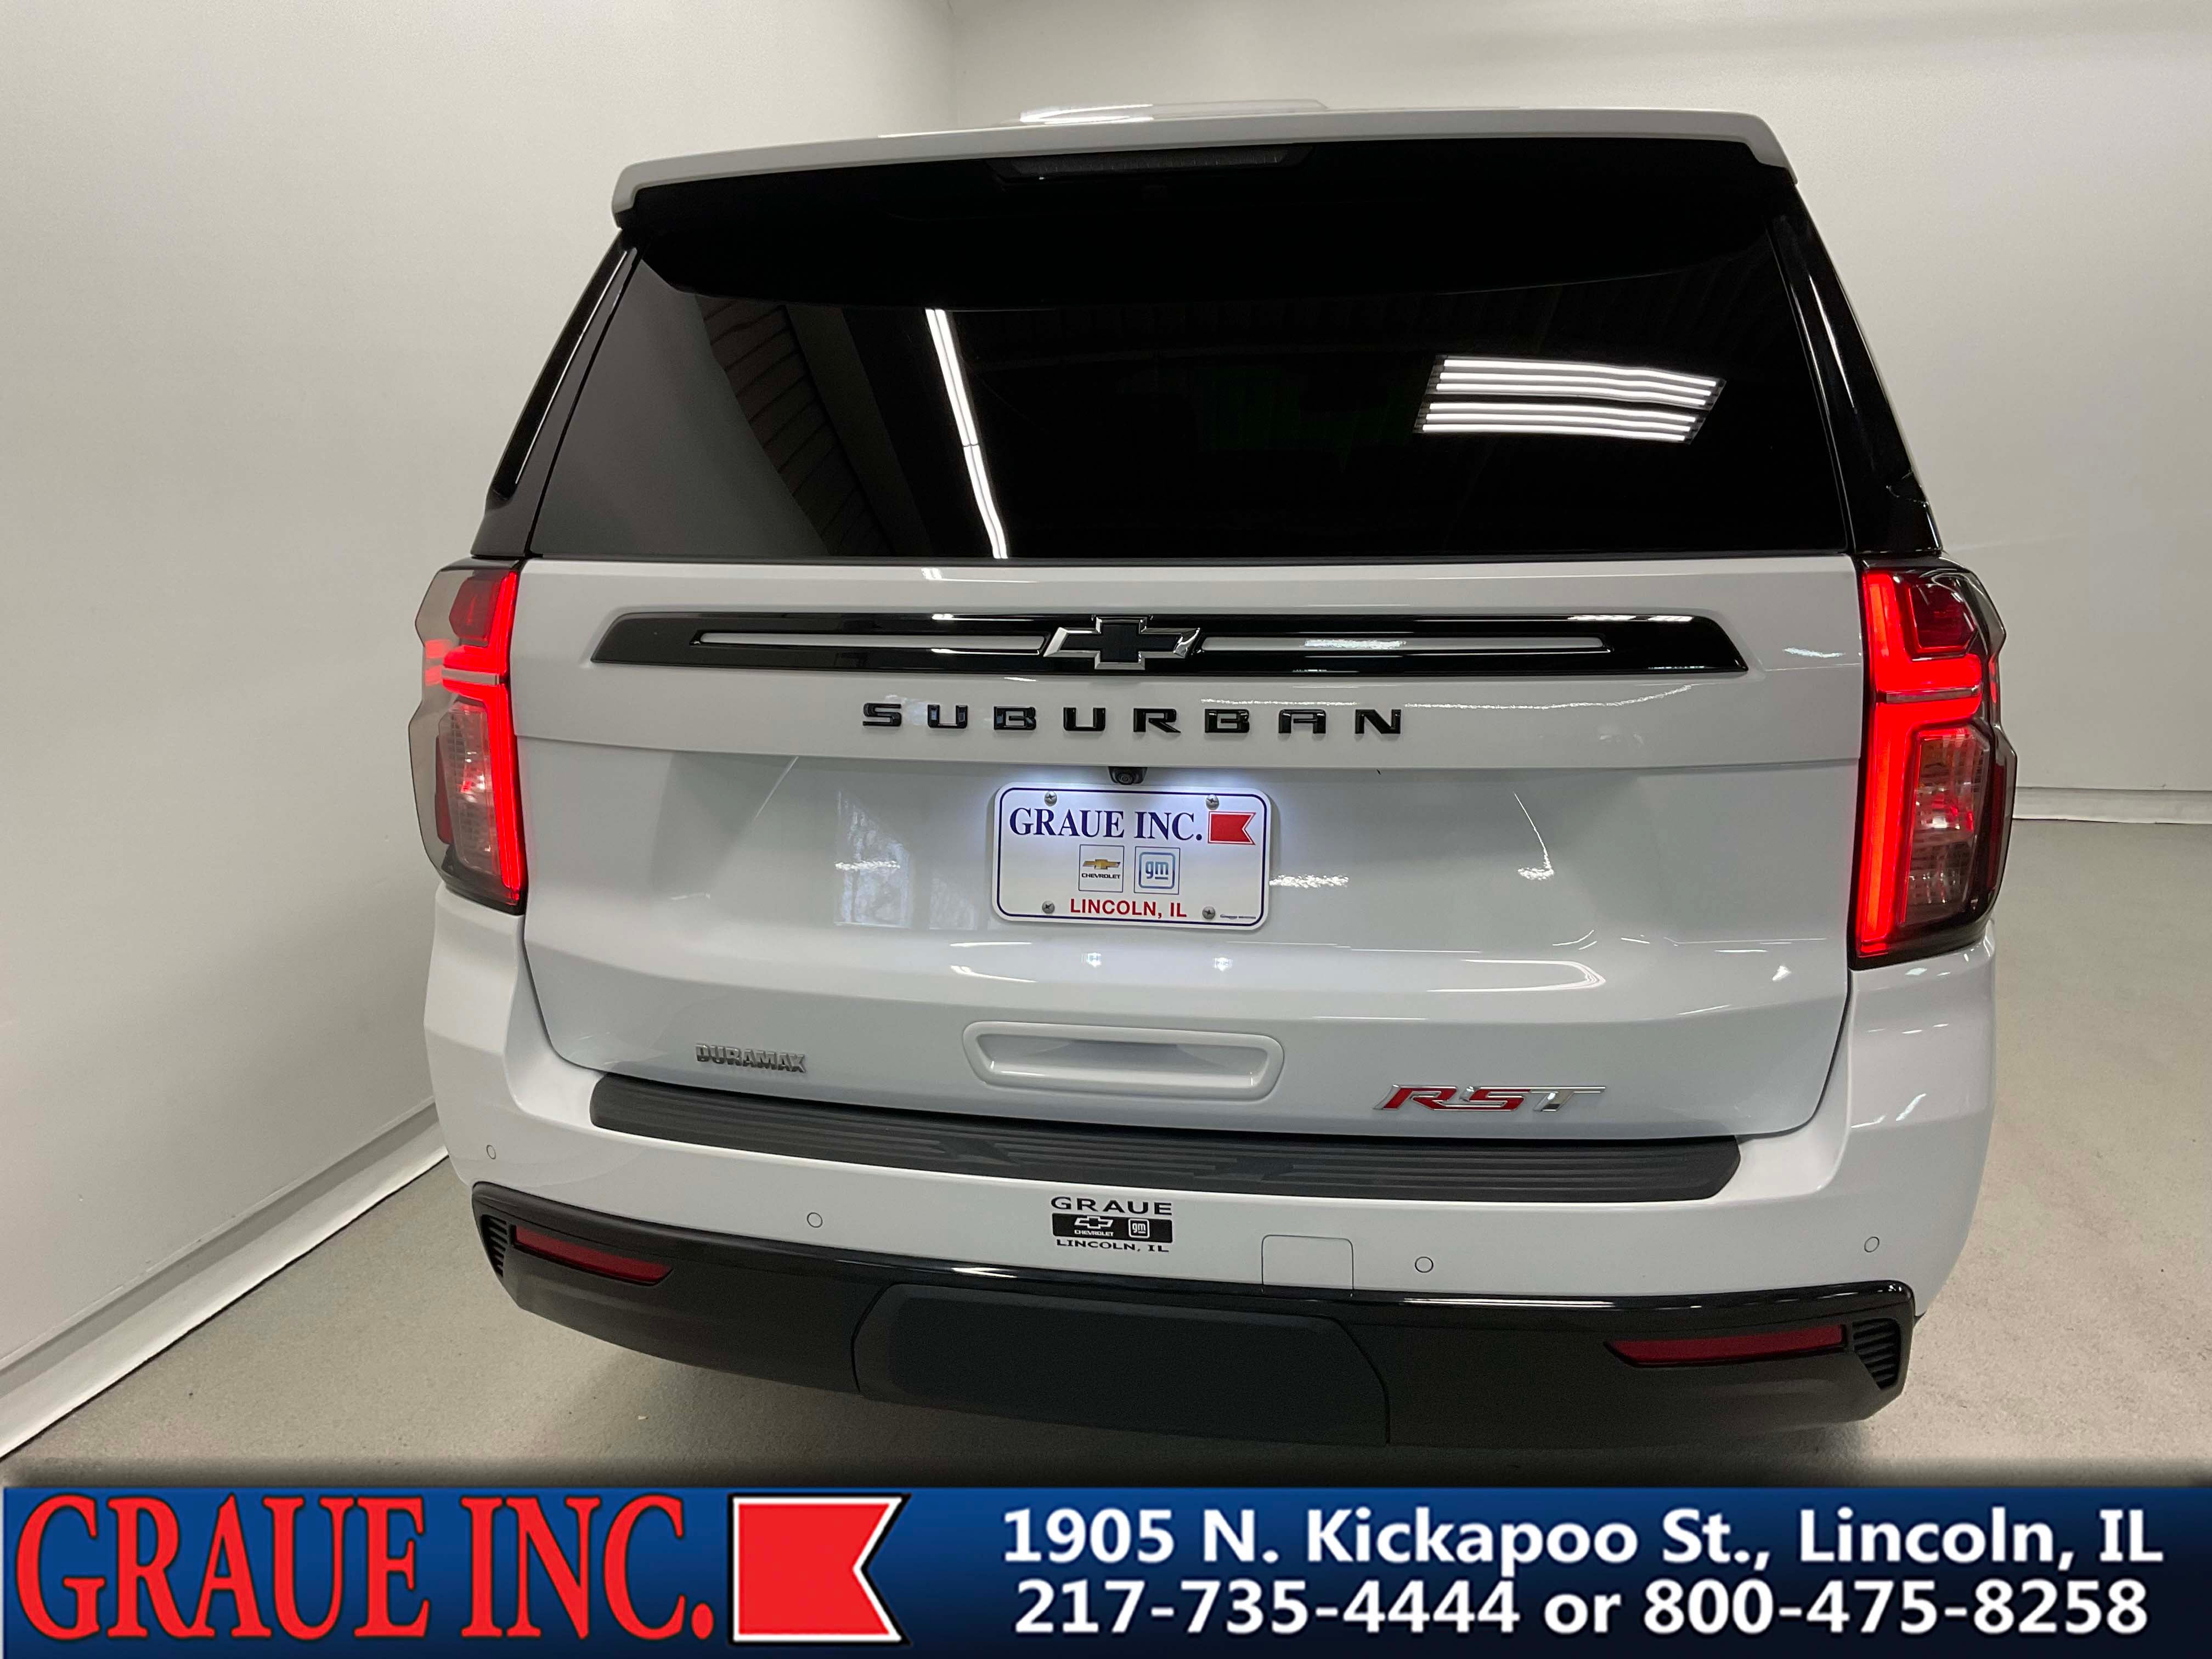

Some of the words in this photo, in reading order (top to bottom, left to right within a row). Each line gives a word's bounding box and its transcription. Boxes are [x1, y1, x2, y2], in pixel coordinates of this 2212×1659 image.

[862, 702, 1401, 735] SUBURBAN
[1009, 807, 1124, 838] GRAUE
[1133, 811, 1203, 842] INC.
[1145, 860, 1169, 880] gm
[1070, 898, 1163, 919] LINCOLN,
[1170, 902, 1187, 918] IL
[695, 1043, 806, 1073] DURAMAX
[1372, 1084, 1606, 1112] RST
[1051, 1196, 1172, 1216] GRAUE
[1074, 1229, 1114, 1237] CHEVROLET
[1132, 1222, 1146, 1234] gm
[1056, 1239, 1141, 1252] LINCOLN,
[1148, 1244, 1169, 1252] IL
